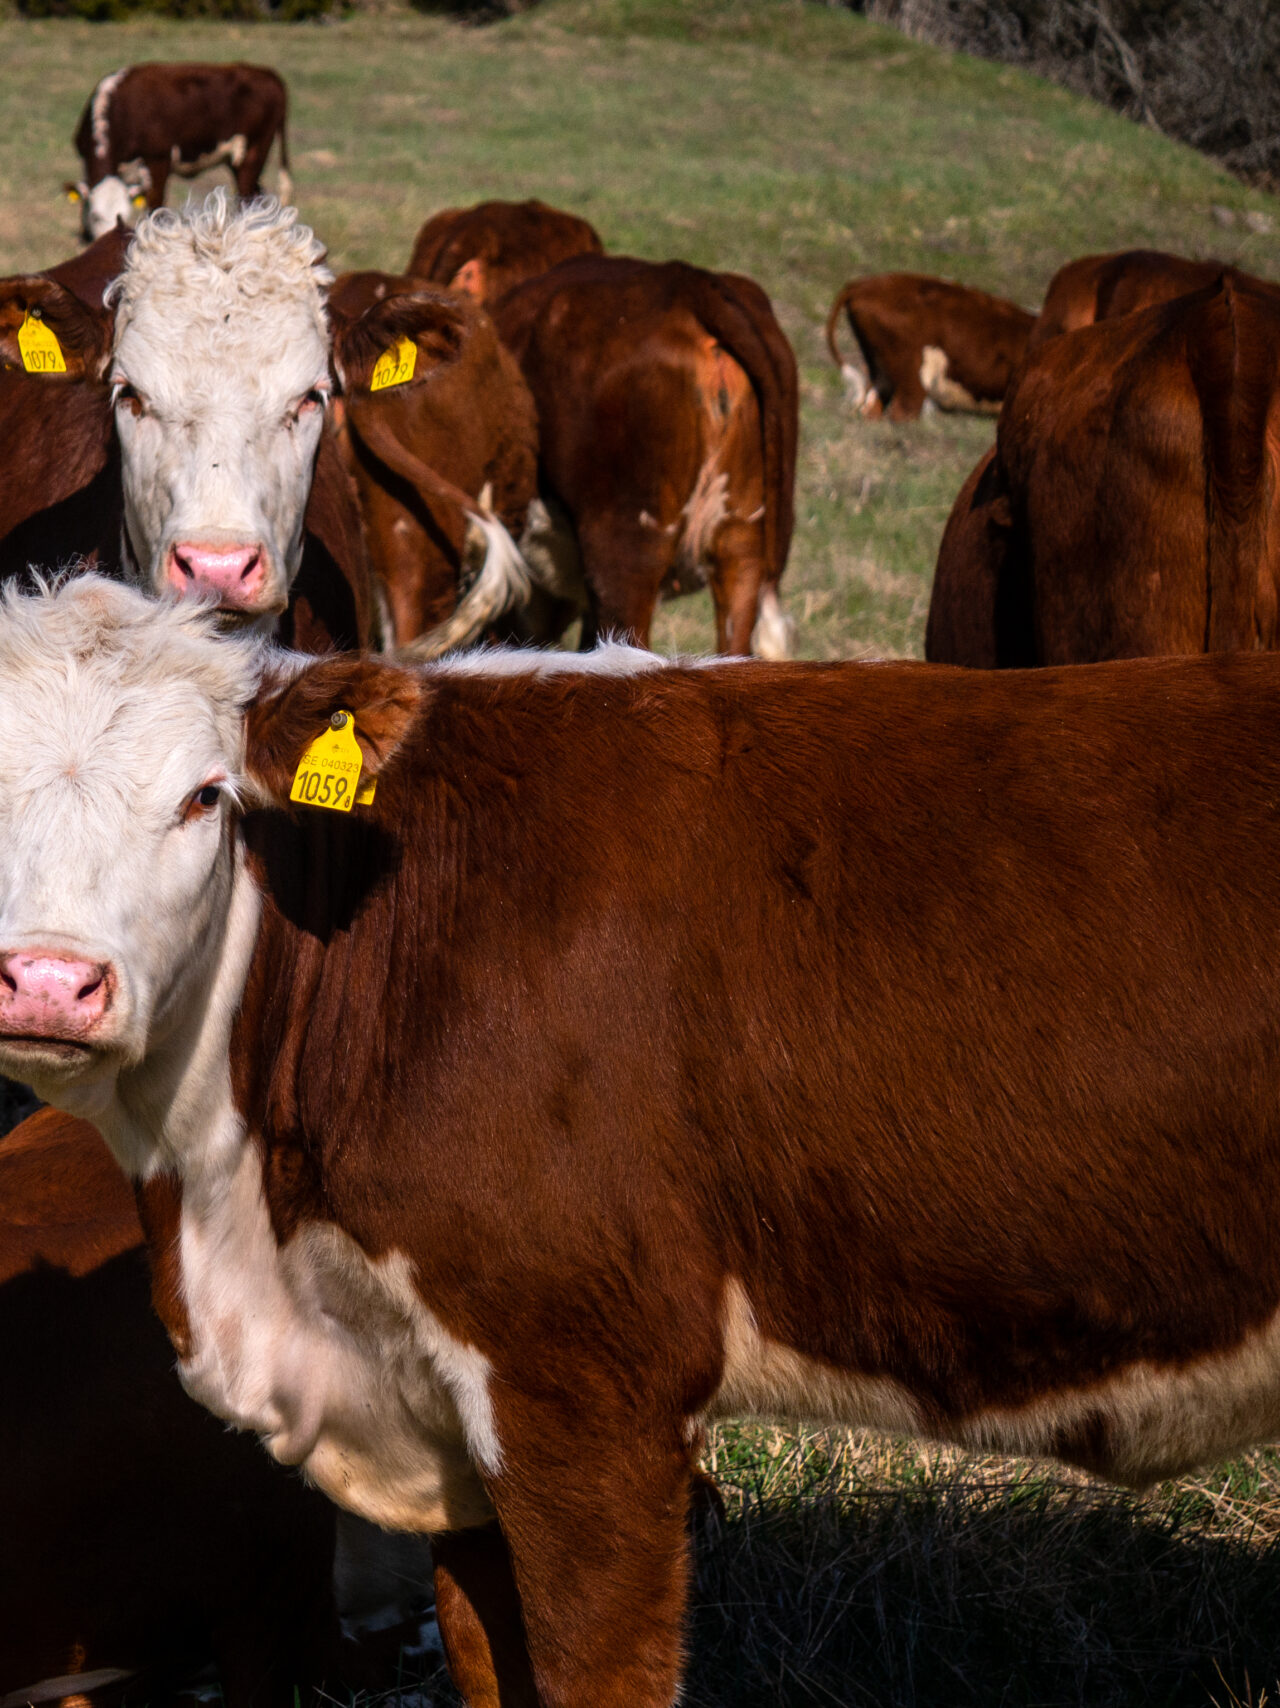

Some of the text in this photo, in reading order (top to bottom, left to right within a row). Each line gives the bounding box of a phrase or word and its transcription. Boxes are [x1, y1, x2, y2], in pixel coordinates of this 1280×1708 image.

[25, 350, 57, 370] 1079
[375, 362, 408, 387] 1079
[302, 754, 359, 773] SE 040323
[298, 770, 348, 806] 1059
